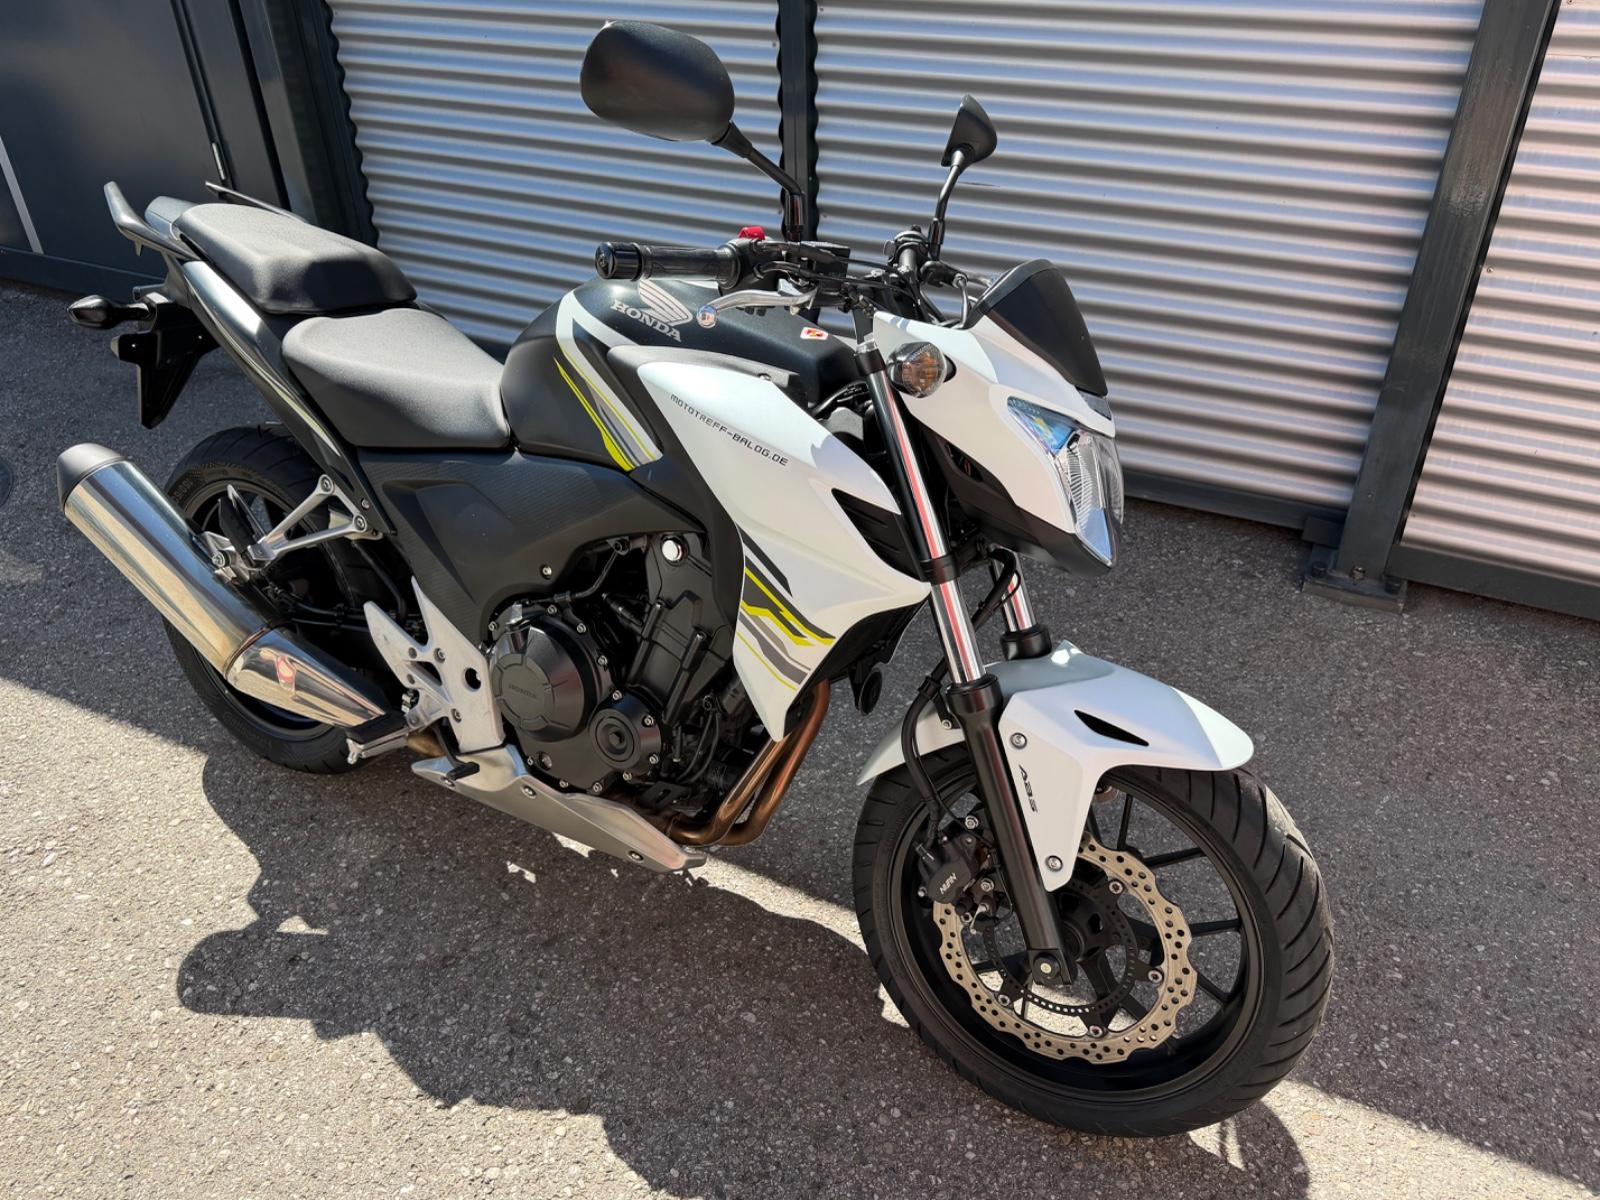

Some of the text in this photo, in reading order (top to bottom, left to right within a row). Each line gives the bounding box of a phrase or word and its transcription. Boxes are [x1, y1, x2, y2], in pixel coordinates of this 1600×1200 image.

[610, 298, 682, 342] HONDA
[670, 394, 789, 466] MOTOTREFF-BALOG.DE
[1018, 764, 1038, 812] ABS
